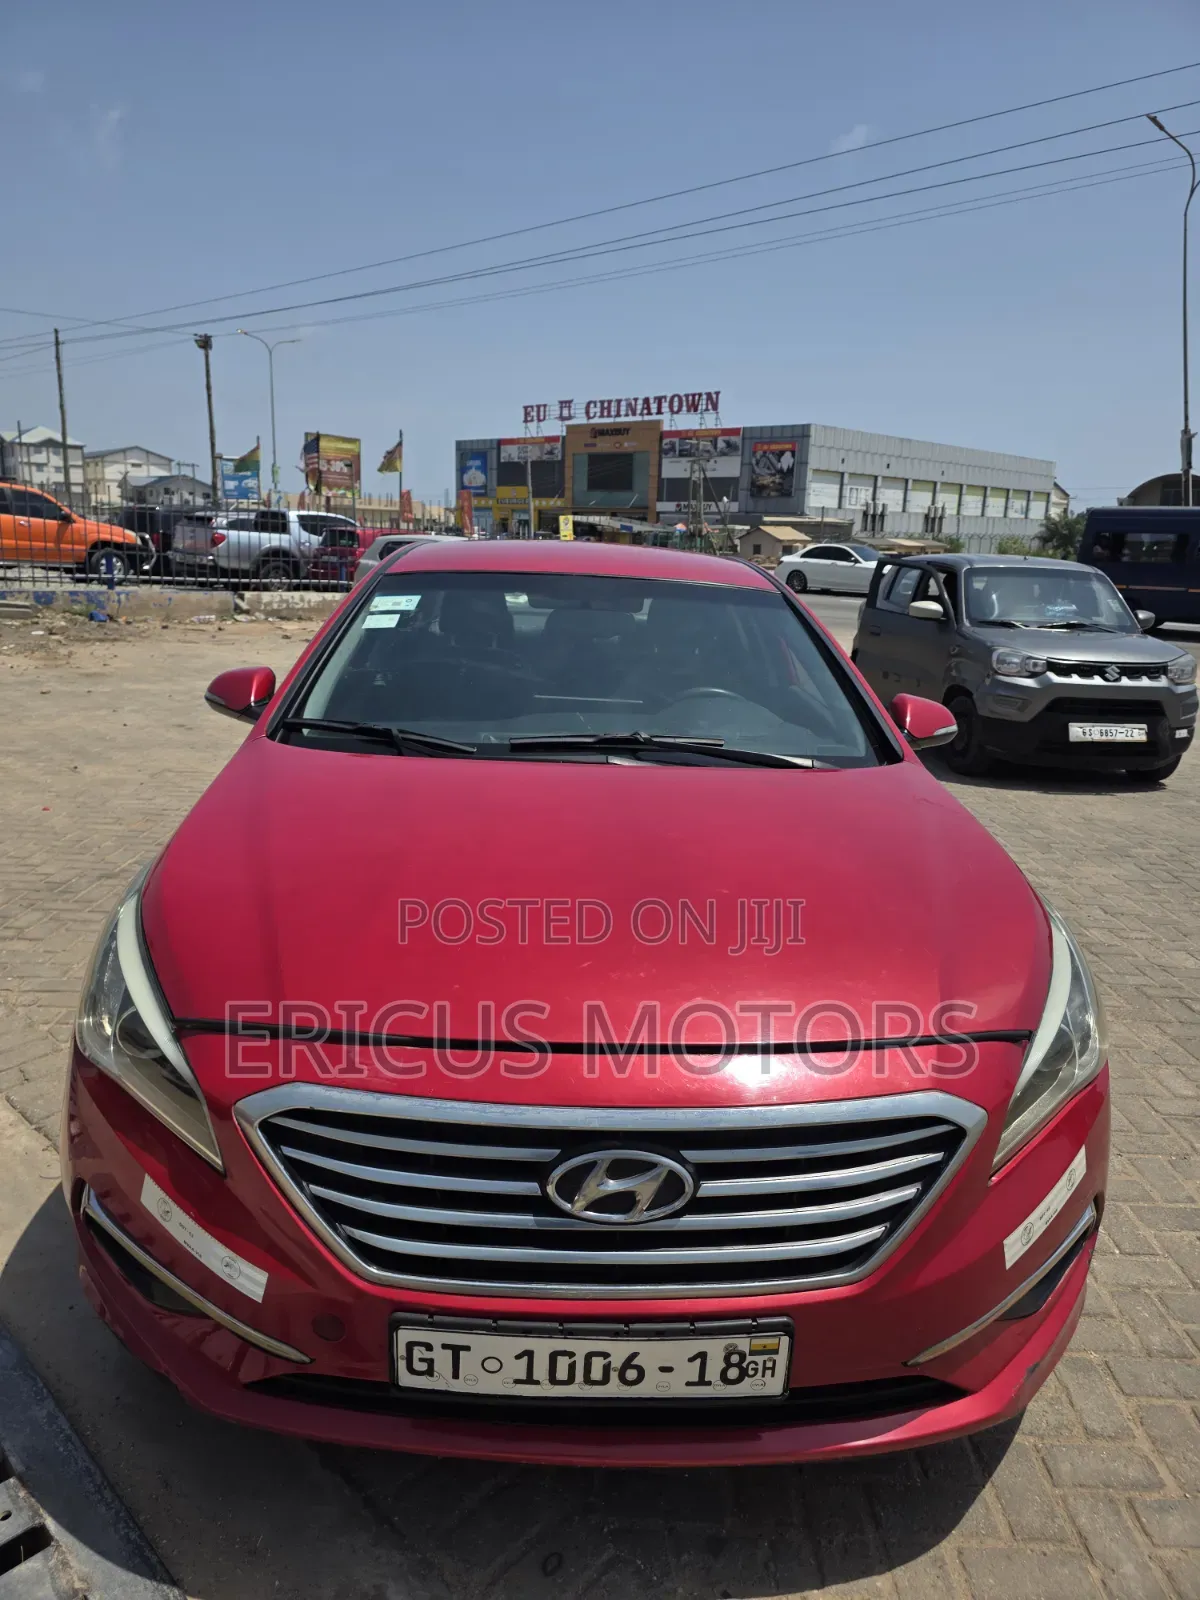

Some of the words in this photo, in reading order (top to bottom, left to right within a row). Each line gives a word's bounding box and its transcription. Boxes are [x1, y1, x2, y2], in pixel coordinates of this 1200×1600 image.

[523, 403, 547, 423] EU
[585, 391, 721, 420] CHINATOWN
[405, 1340, 471, 1380] GT
[746, 1360, 776, 1378] GH
